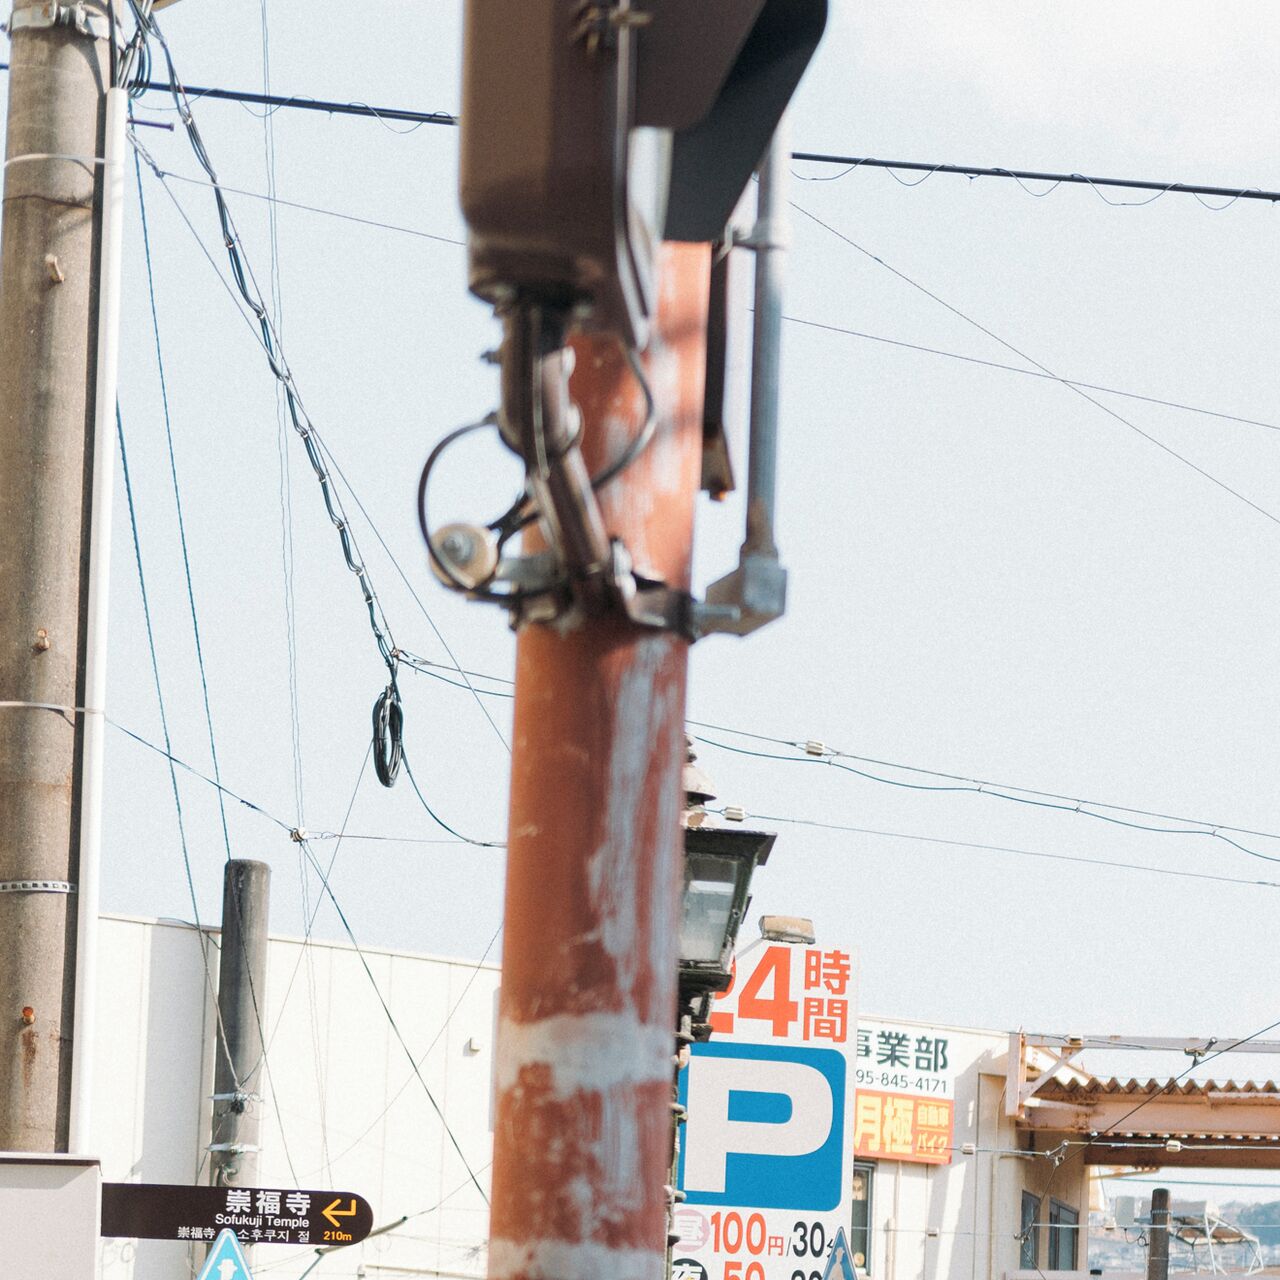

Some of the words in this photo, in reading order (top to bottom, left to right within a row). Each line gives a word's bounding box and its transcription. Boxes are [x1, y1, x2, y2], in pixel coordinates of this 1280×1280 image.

[803, 949, 850, 1043] 時間
[856, 1069, 947, 1094] 95-845-4171
[684, 1055, 833, 1193] P
[854, 1095, 914, 1155] 月極
[917, 1104, 949, 1127] 自動車
[916, 1133, 948, 1154] バイク
[226, 1190, 310, 1216] 崇福寺
[215, 1214, 263, 1227] Sofukuji
[266, 1216, 310, 1229] Temple
[298, 1230, 310, 1243] 절
[323, 1231, 352, 1241] 210m
